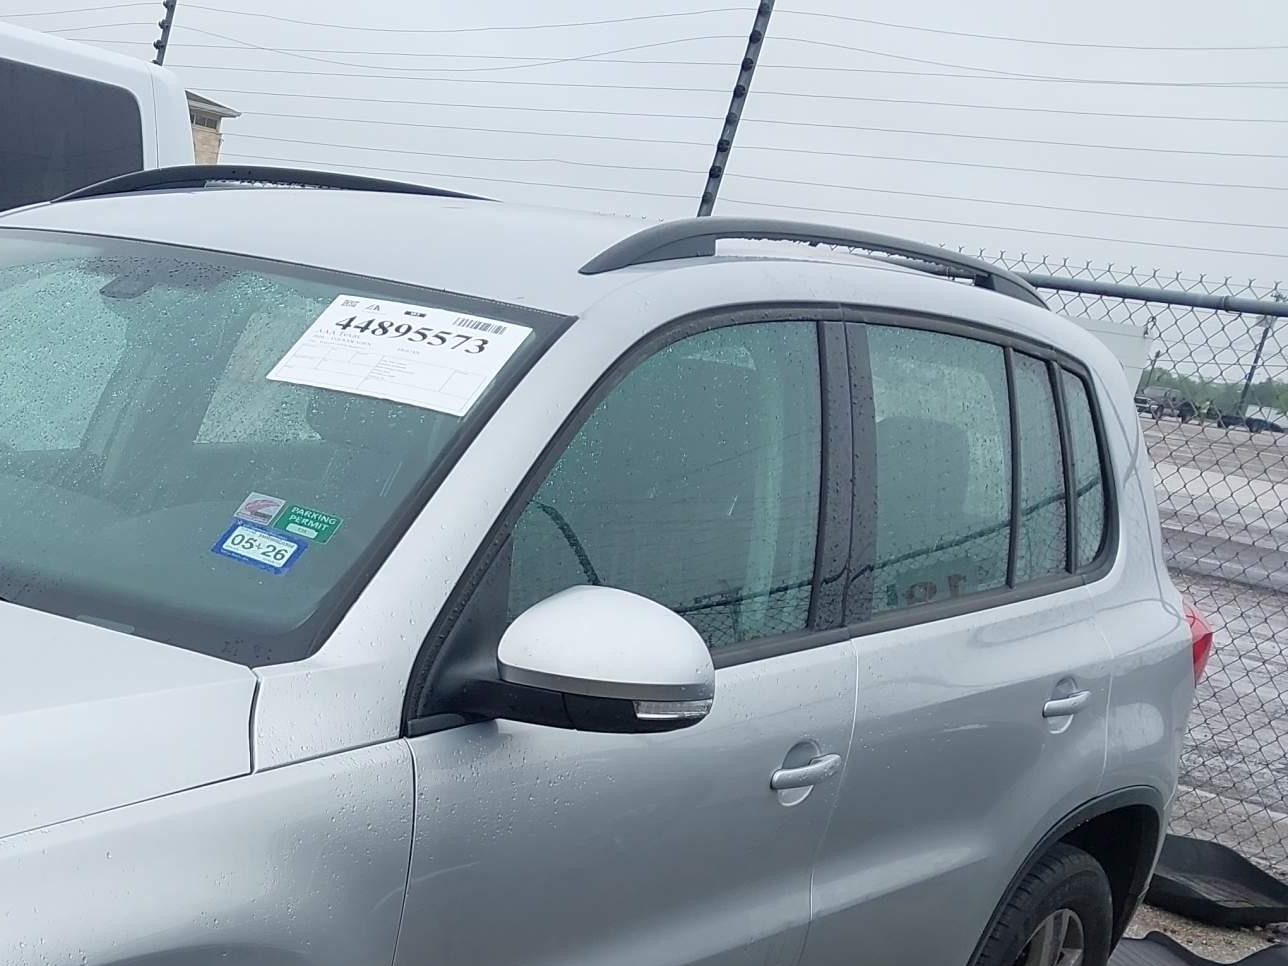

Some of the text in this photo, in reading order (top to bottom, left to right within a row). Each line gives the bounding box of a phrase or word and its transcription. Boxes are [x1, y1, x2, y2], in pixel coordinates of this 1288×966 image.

[335, 315, 489, 354] 44895573
[289, 515, 329, 531] PERMIT
[291, 507, 337, 525] PARKING
